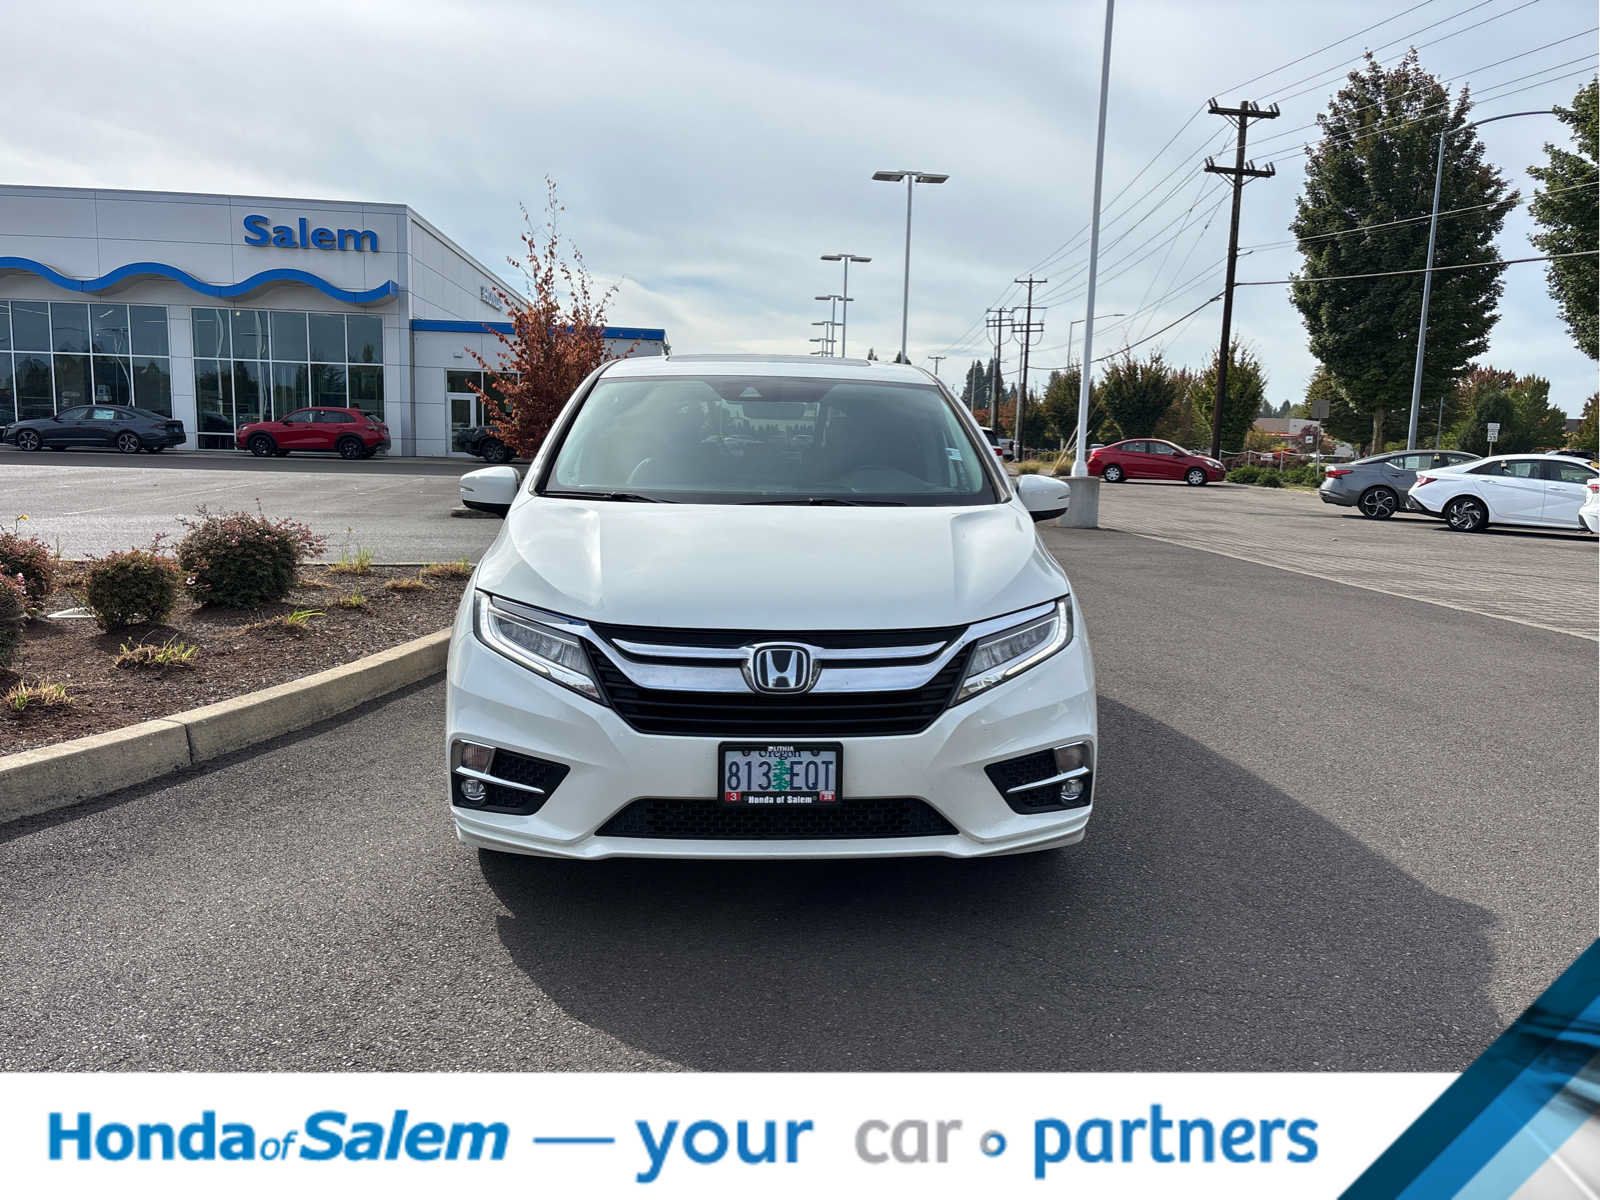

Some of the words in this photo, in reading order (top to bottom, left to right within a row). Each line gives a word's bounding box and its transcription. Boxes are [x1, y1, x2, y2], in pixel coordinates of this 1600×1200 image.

[243, 213, 379, 253] Salem
[758, 750, 802, 760] Oregon
[727, 761, 772, 791] 813
[789, 760, 834, 791] EQT
[748, 795, 774, 804] Honda
[776, 795, 785, 804] of
[786, 795, 813, 804] Salem
